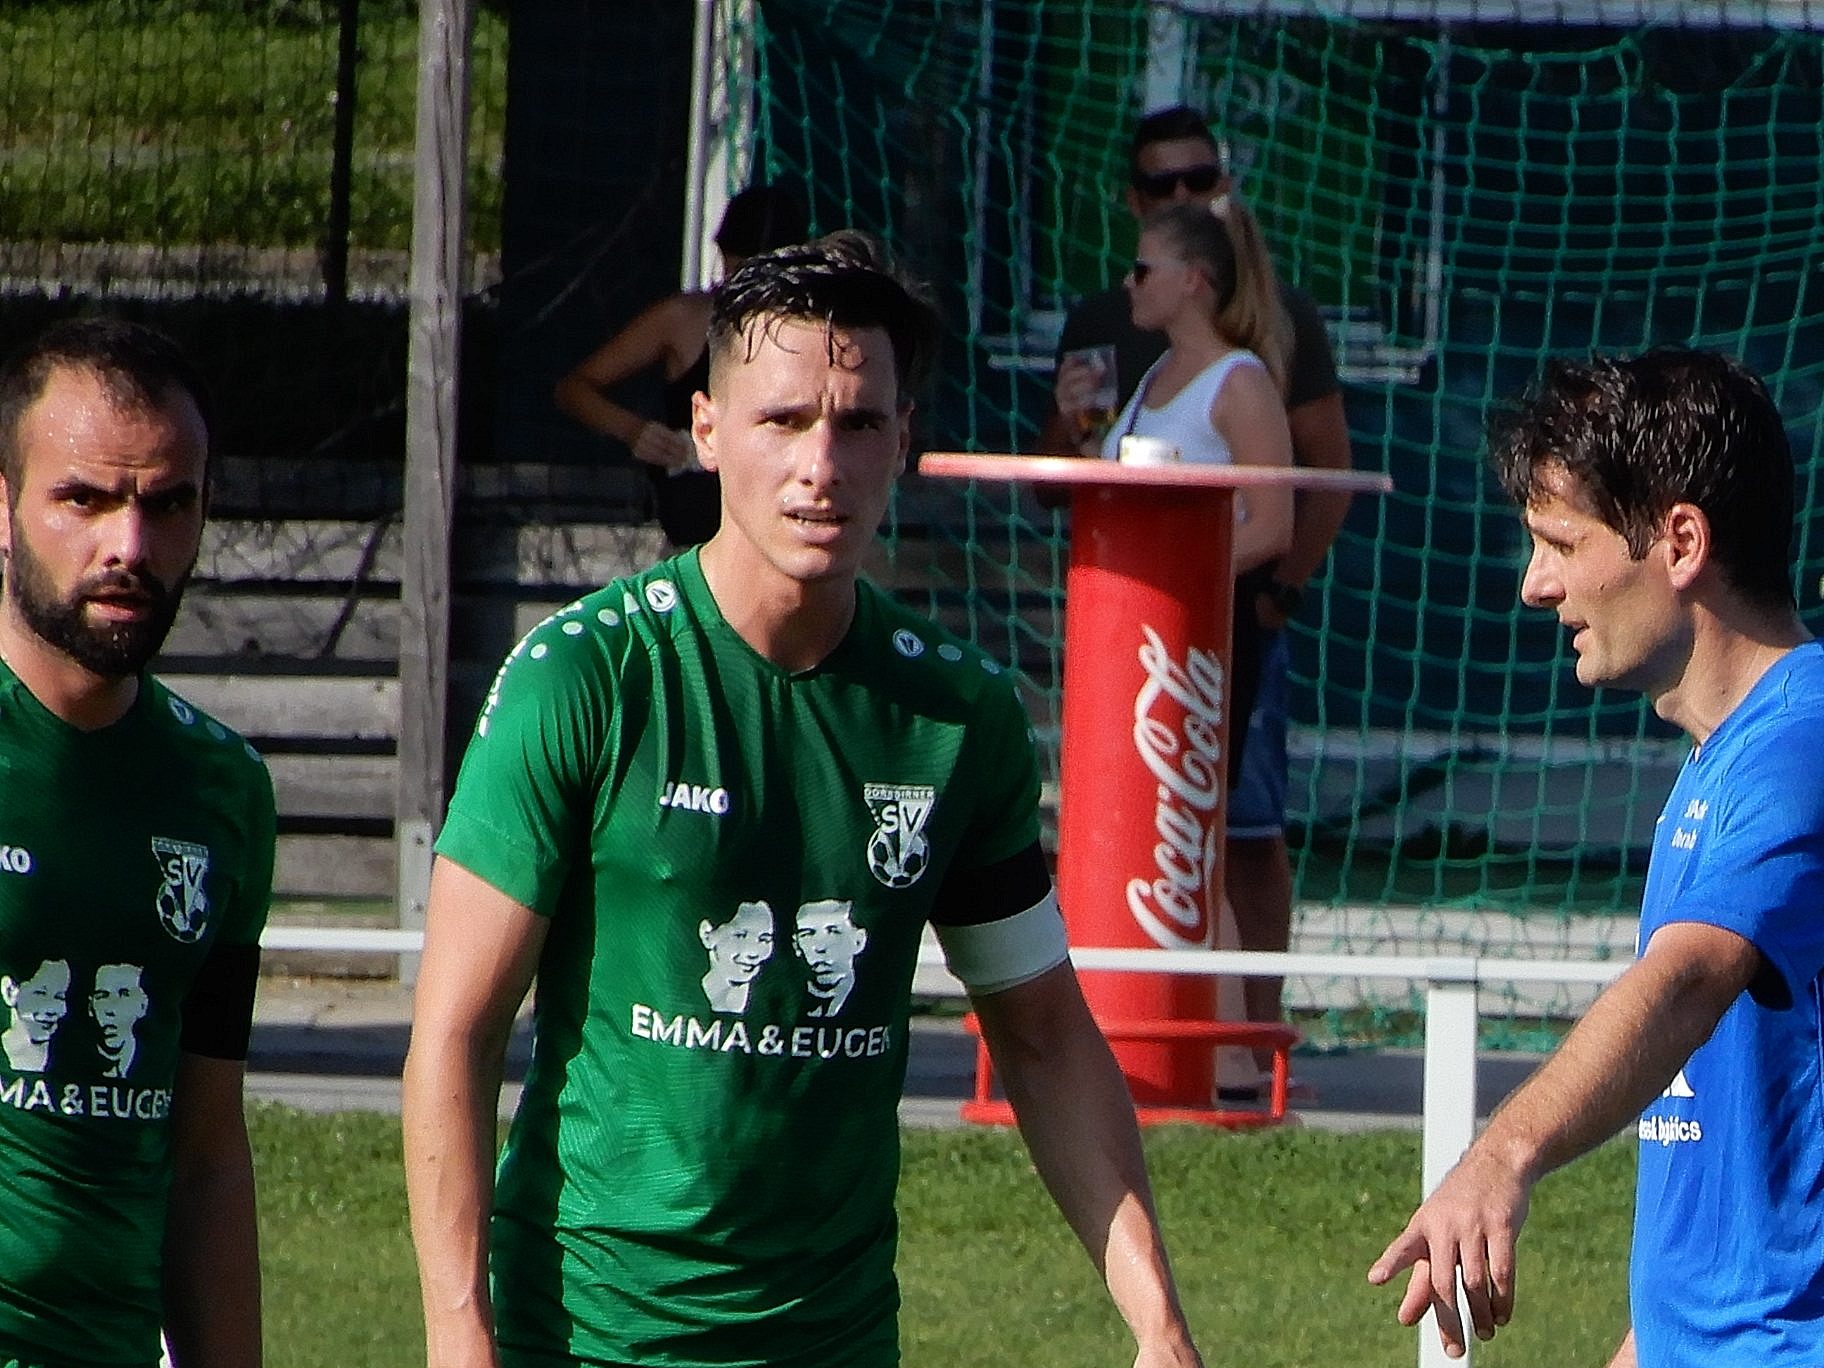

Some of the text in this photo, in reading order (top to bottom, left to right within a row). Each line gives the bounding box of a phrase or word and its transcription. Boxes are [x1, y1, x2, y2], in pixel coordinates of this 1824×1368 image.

[659, 781, 730, 814] JAKO
[1126, 623, 1224, 951] Coca-Cola
[881, 804, 922, 834] SV
